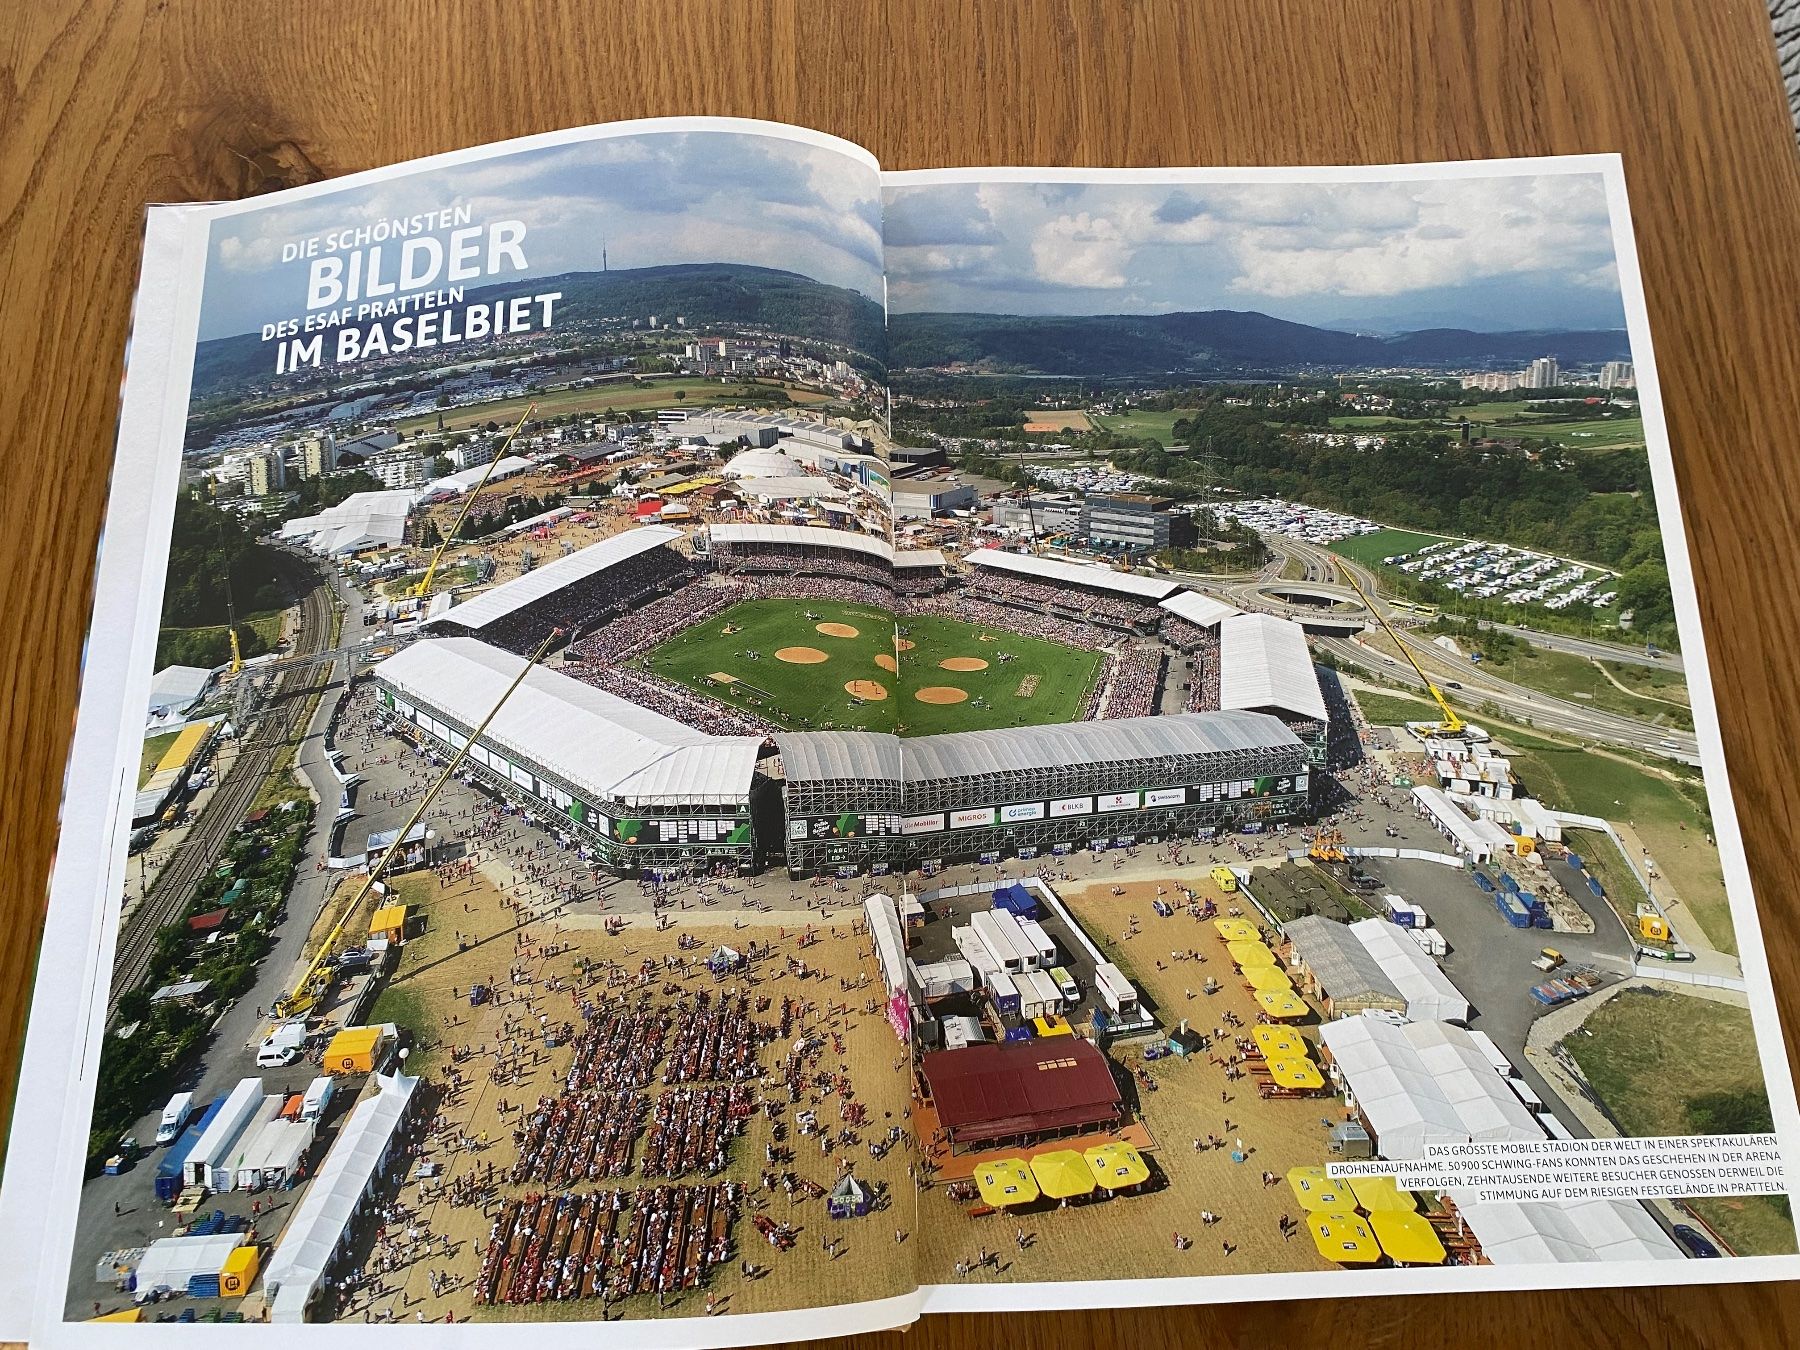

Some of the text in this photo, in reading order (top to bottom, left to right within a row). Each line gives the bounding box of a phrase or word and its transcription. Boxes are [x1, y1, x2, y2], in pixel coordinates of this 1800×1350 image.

[281, 204, 472, 263] DIE SCHÖNSTEN
[306, 219, 529, 310] BILDER
[261, 285, 464, 342] DES ESAF PRATTELN
[276, 292, 562, 375] IM BASELBIET
[957, 814, 987, 822] MIGROS
[1429, 1135, 1778, 1156] DAS GRÖSSTE MOBILE STADION DER WELT IN EINER SPEKTAKULÄREN
[1331, 1161, 1447, 1175] DROHNENAUFNAHME.
[1481, 1157, 1563, 1170] SCHWING-FANS
[1565, 1156, 1617, 1168] KONNTEN
[1619, 1155, 1640, 1165] DAS
[1642, 1152, 1706, 1165] GESCHEHEN
[1708, 1152, 1720, 1163] IN
[1722, 1152, 1743, 1162] DER
[1745, 1151, 1782, 1162] ARENA
[1400, 1166, 1785, 1189] VERFOLGEN, ZEHNTAUSENDE WEITERE BESUCHER GENOSSEN DERWEIL DIE
[1480, 1181, 1788, 1201] STIMMUNG AUF DEM RIESIGEN FESTGELÄNDE IN PRATTELN.
